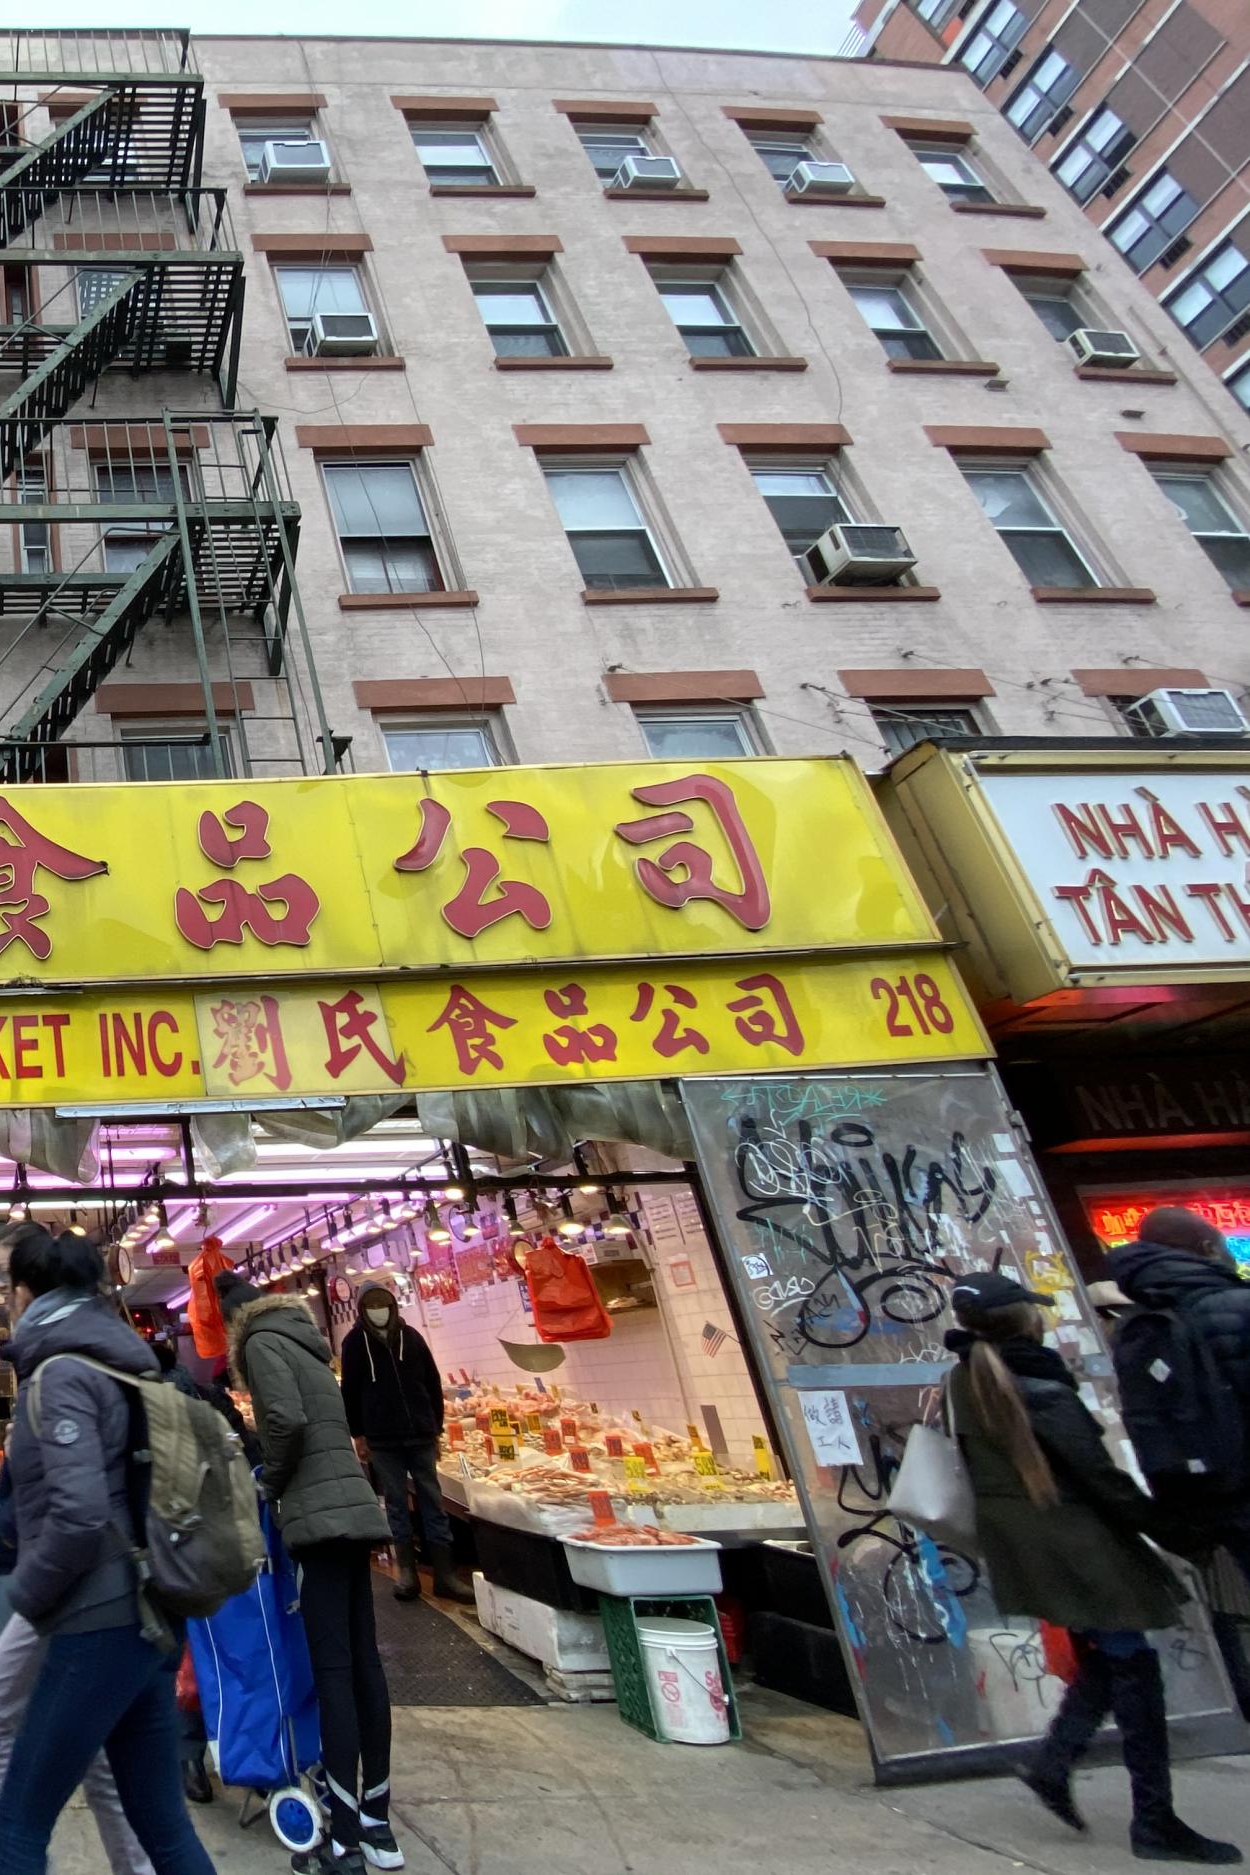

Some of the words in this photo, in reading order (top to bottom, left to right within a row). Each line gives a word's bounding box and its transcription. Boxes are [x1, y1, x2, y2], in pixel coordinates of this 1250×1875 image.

[1051, 786, 1203, 860] NHÀ
[1052, 867, 1195, 946] TÂN
[212, 972, 806, 1091] 劉氏食品公司
[871, 973, 955, 1038] 218
[98, 1012, 201, 1078] INC.
